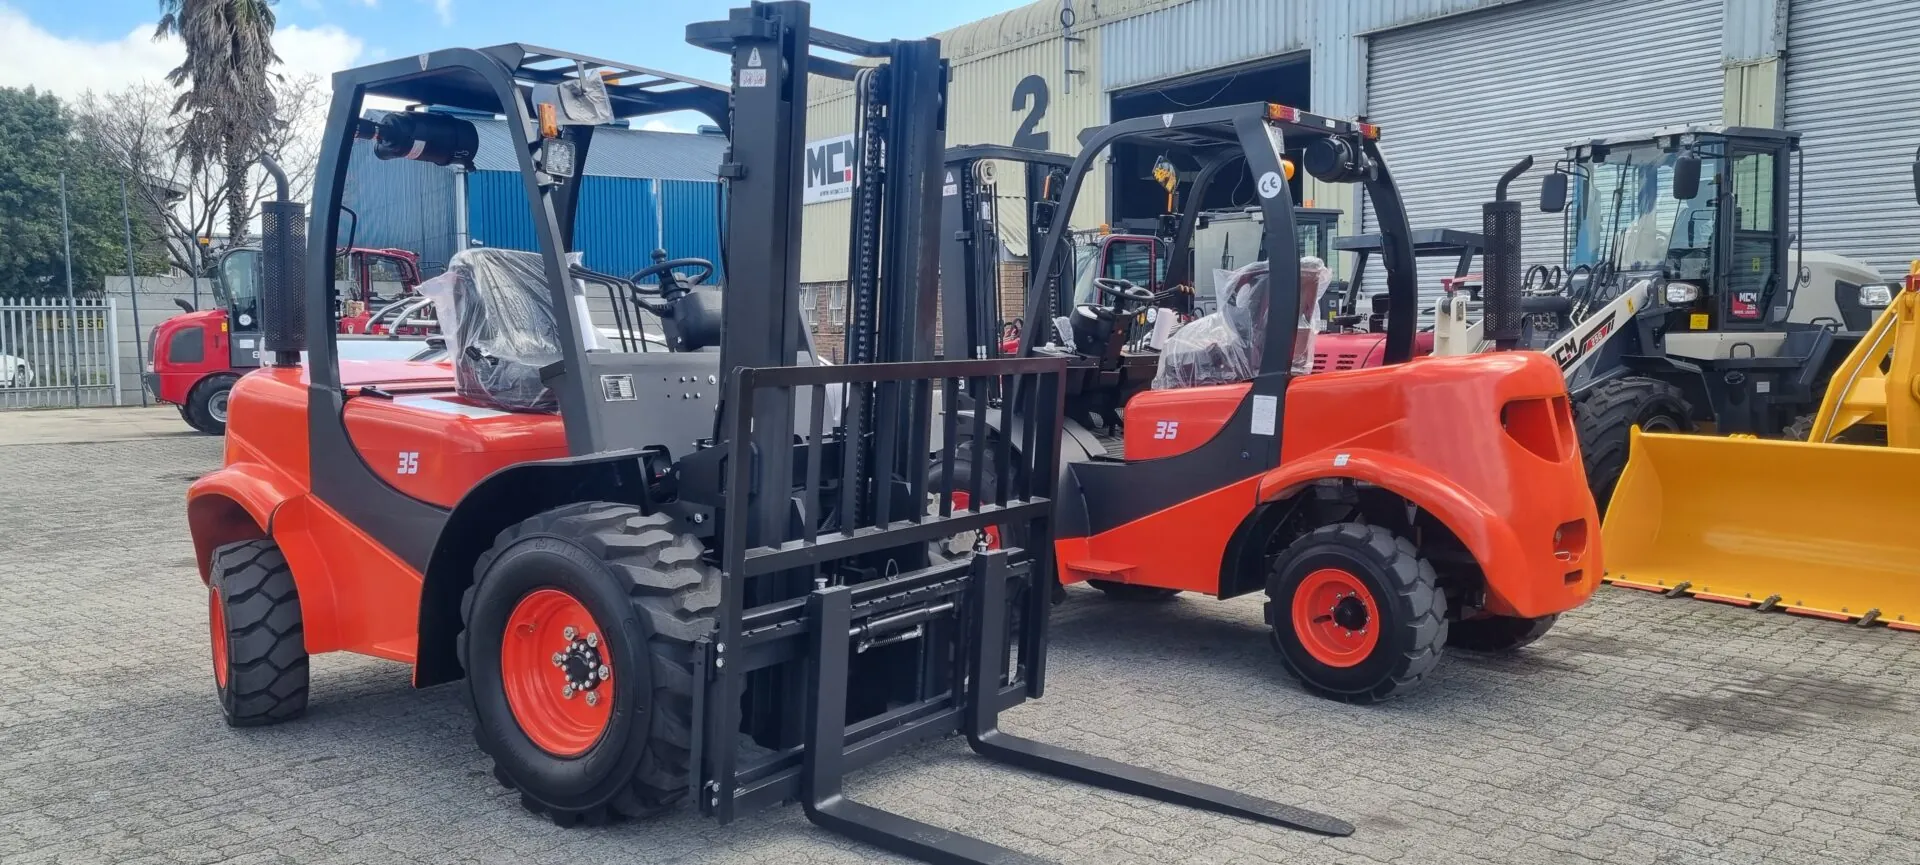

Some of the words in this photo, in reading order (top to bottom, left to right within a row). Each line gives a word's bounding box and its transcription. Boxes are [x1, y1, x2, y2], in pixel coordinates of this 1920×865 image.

[1012, 74, 1048, 149] 2
[1739, 292, 1757, 302] MCM
[1551, 336, 1577, 367] CM
[1591, 331, 1604, 346] 25G
[1153, 421, 1179, 440] 35
[397, 451, 419, 475] 35
